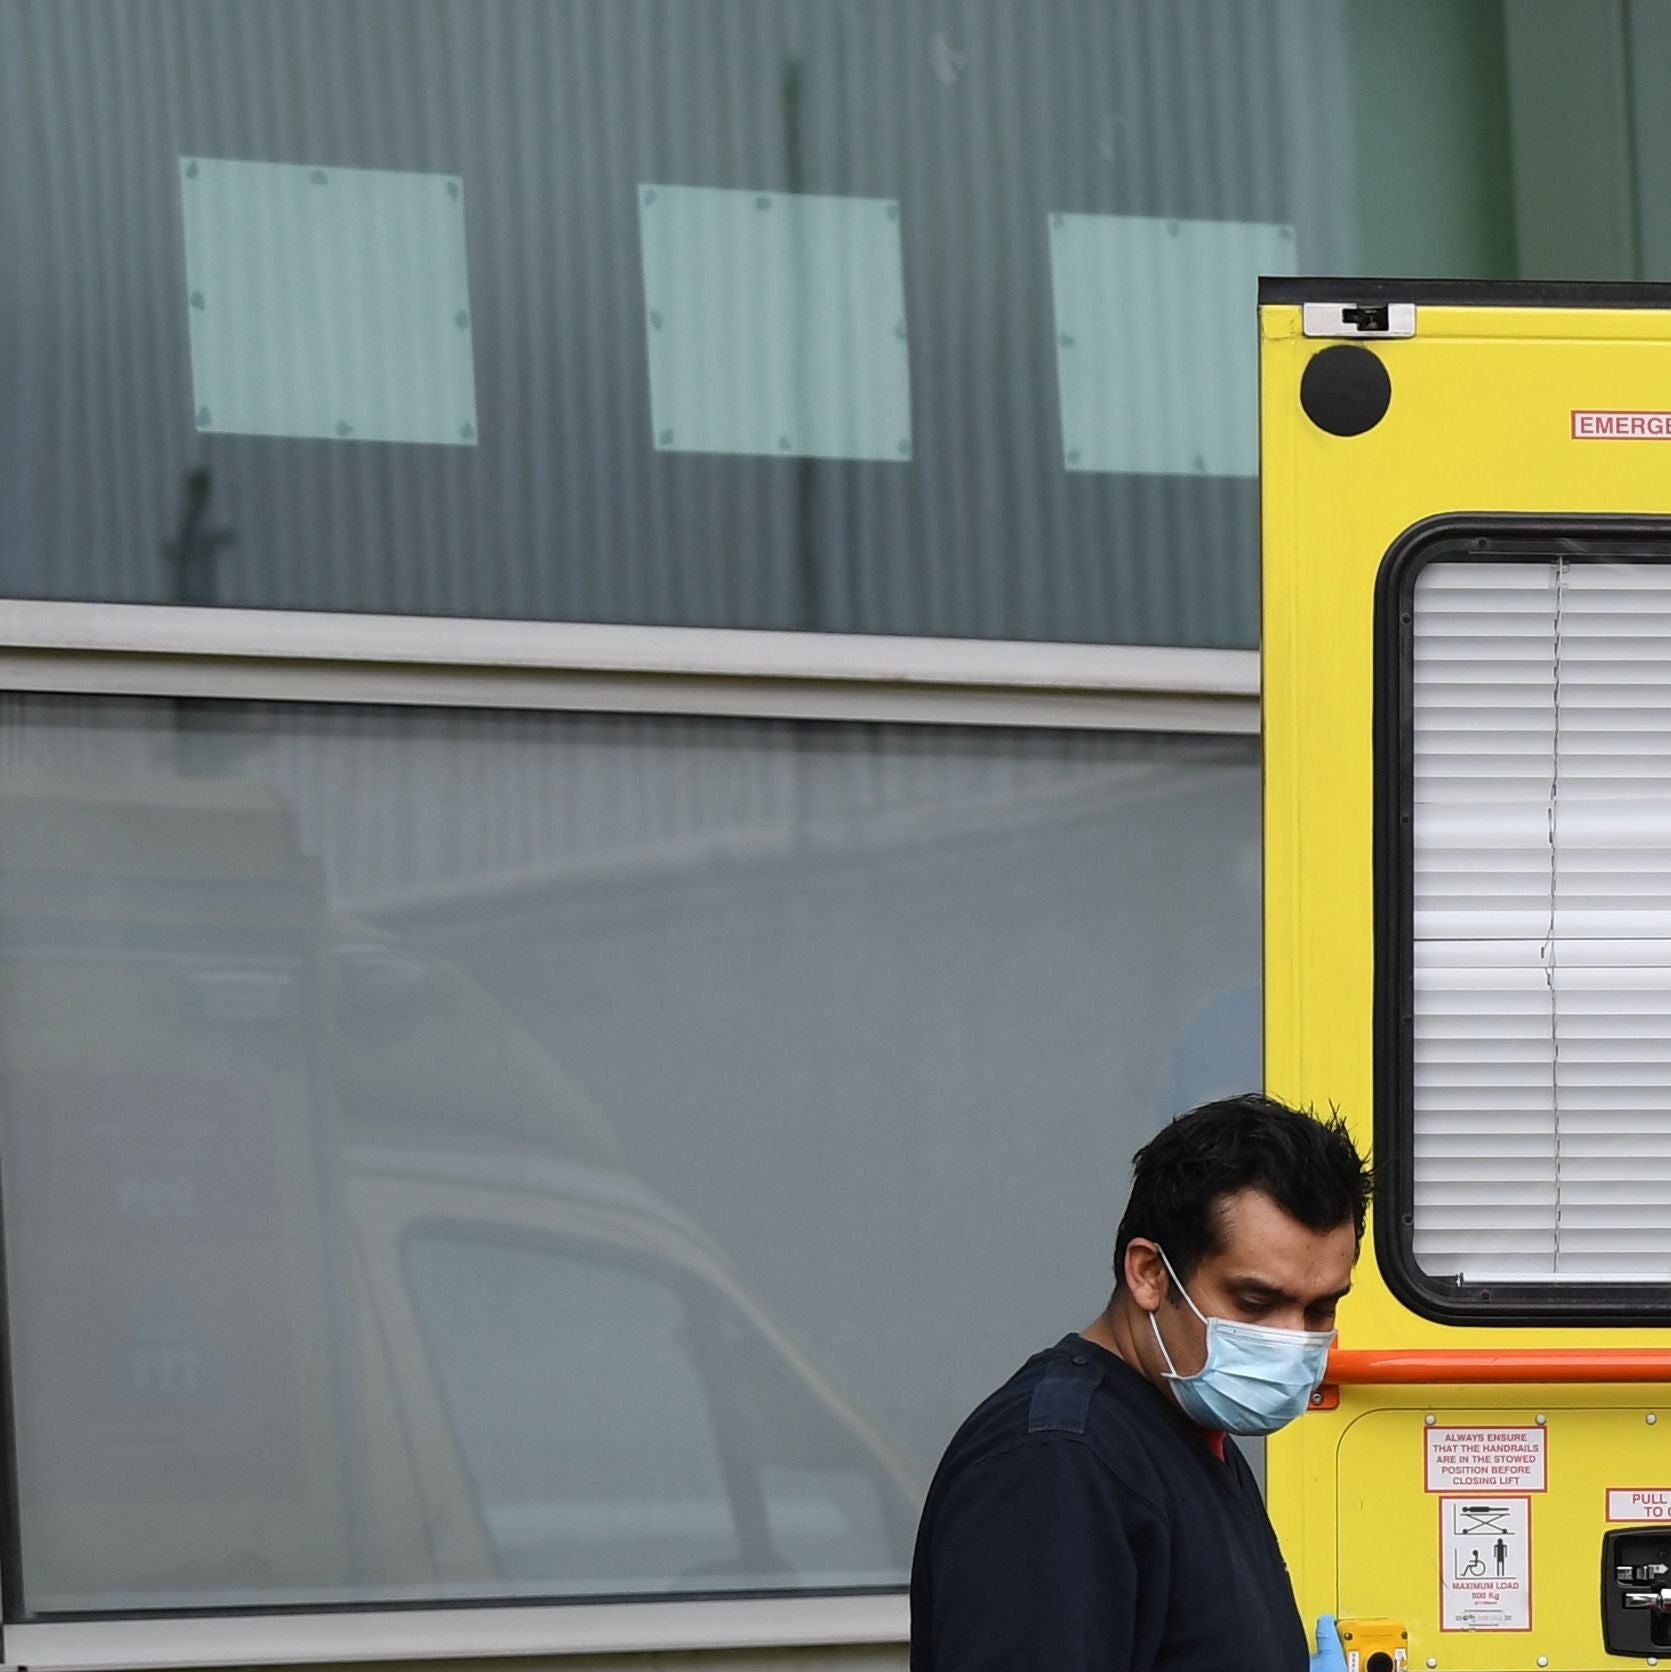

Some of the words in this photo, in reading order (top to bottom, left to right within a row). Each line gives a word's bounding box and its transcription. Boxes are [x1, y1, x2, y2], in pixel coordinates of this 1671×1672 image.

[1445, 1433, 1484, 1442] ALWAYS
[1487, 1433, 1527, 1442] ENSURE
[1432, 1444, 1458, 1453] THAT
[1460, 1444, 1480, 1453] THE
[1482, 1444, 1539, 1453] HANDRAILS
[1436, 1455, 1456, 1463] ARE
[1459, 1455, 1469, 1463] IN
[1472, 1455, 1491, 1463] THE
[1493, 1455, 1536, 1463] STOWED
[1441, 1466, 1488, 1474] POSITION
[1491, 1466, 1531, 1474] BEFORE
[1452, 1476, 1496, 1485] CLOSING
[1500, 1476, 1520, 1485] LIFT
[1632, 1493, 1668, 1504] PULL
[1644, 1506, 1663, 1517] TO
[1452, 1582, 1494, 1590] MAXIMUM
[1496, 1582, 1520, 1590] LOAD
